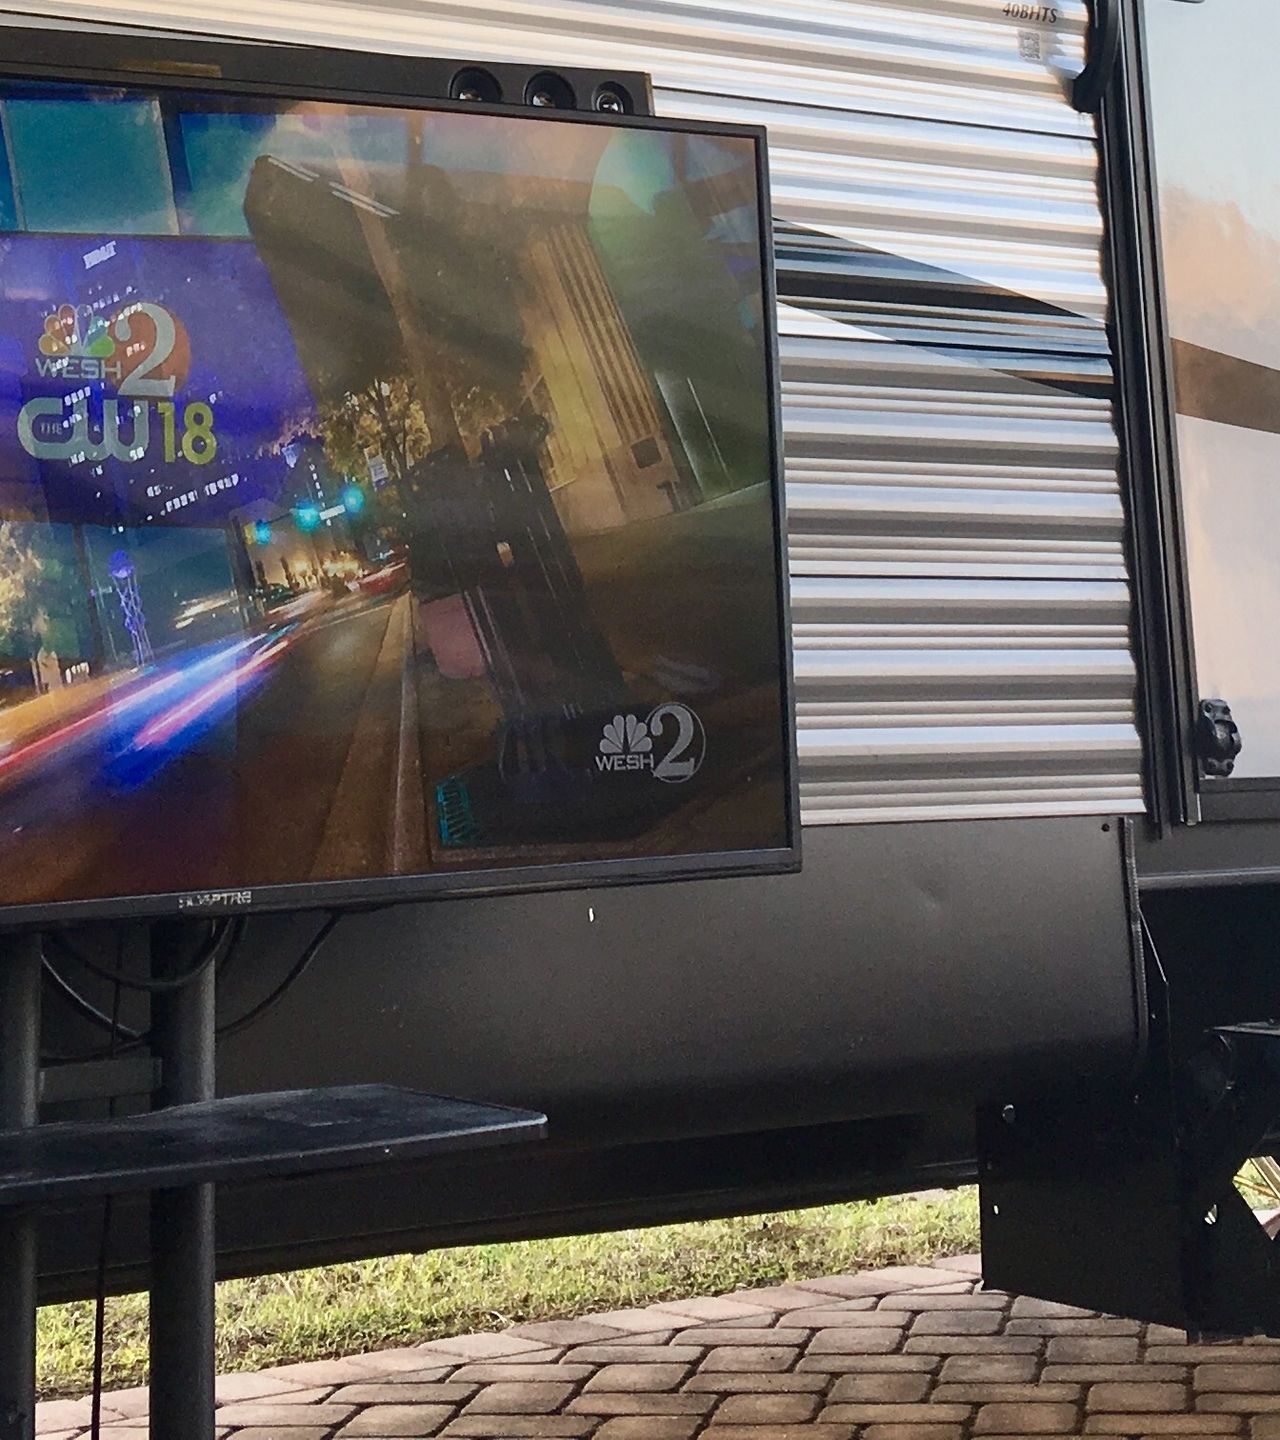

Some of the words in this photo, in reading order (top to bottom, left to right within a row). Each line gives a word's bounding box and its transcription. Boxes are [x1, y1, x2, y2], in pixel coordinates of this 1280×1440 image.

[1002, 2, 1058, 24] 40BHTS
[34, 356, 122, 380] WESH
[114, 302, 177, 397] 2
[157, 401, 218, 465] 18
[594, 753, 655, 772] WESH
[649, 704, 696, 778] 2
